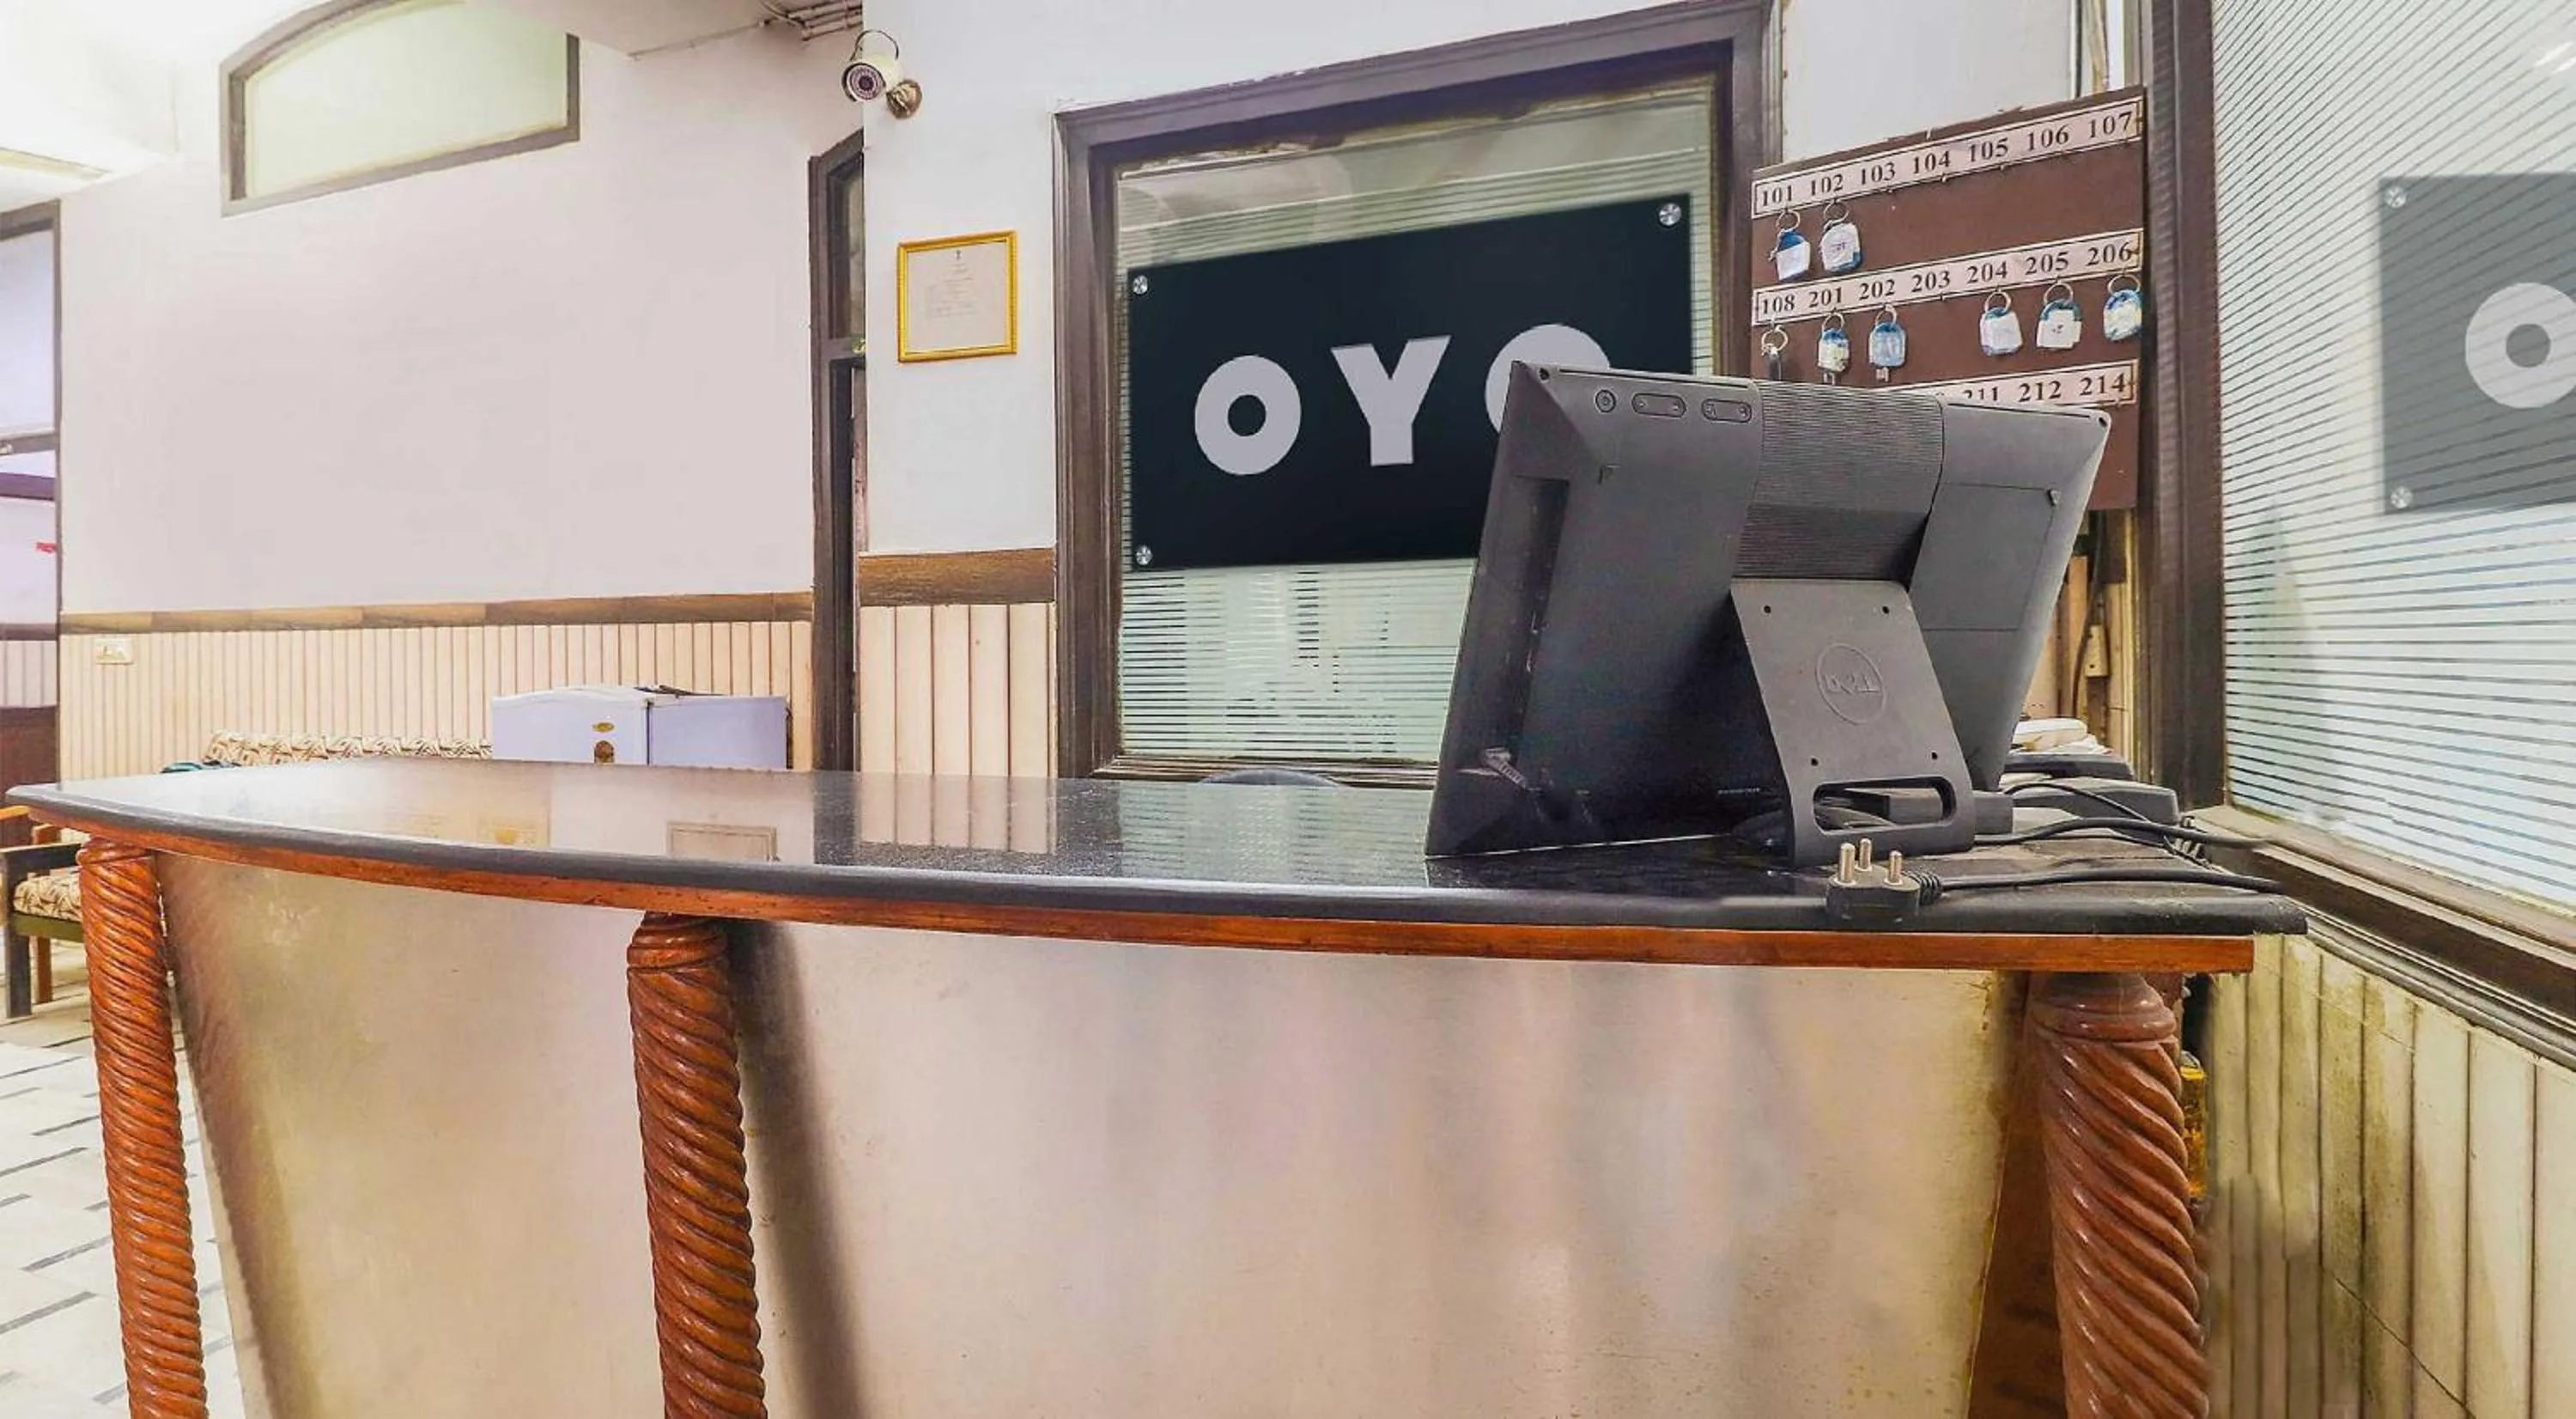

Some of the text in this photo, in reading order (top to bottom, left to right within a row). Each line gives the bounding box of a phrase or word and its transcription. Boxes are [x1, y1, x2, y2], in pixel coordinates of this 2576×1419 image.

[1762, 111, 2133, 207] 101 102 103 104 105 106 107
[1762, 241, 2131, 315] 108 201 202 203 204 205 206
[2018, 380, 2062, 403] 212
[2080, 372, 2126, 397] 214
